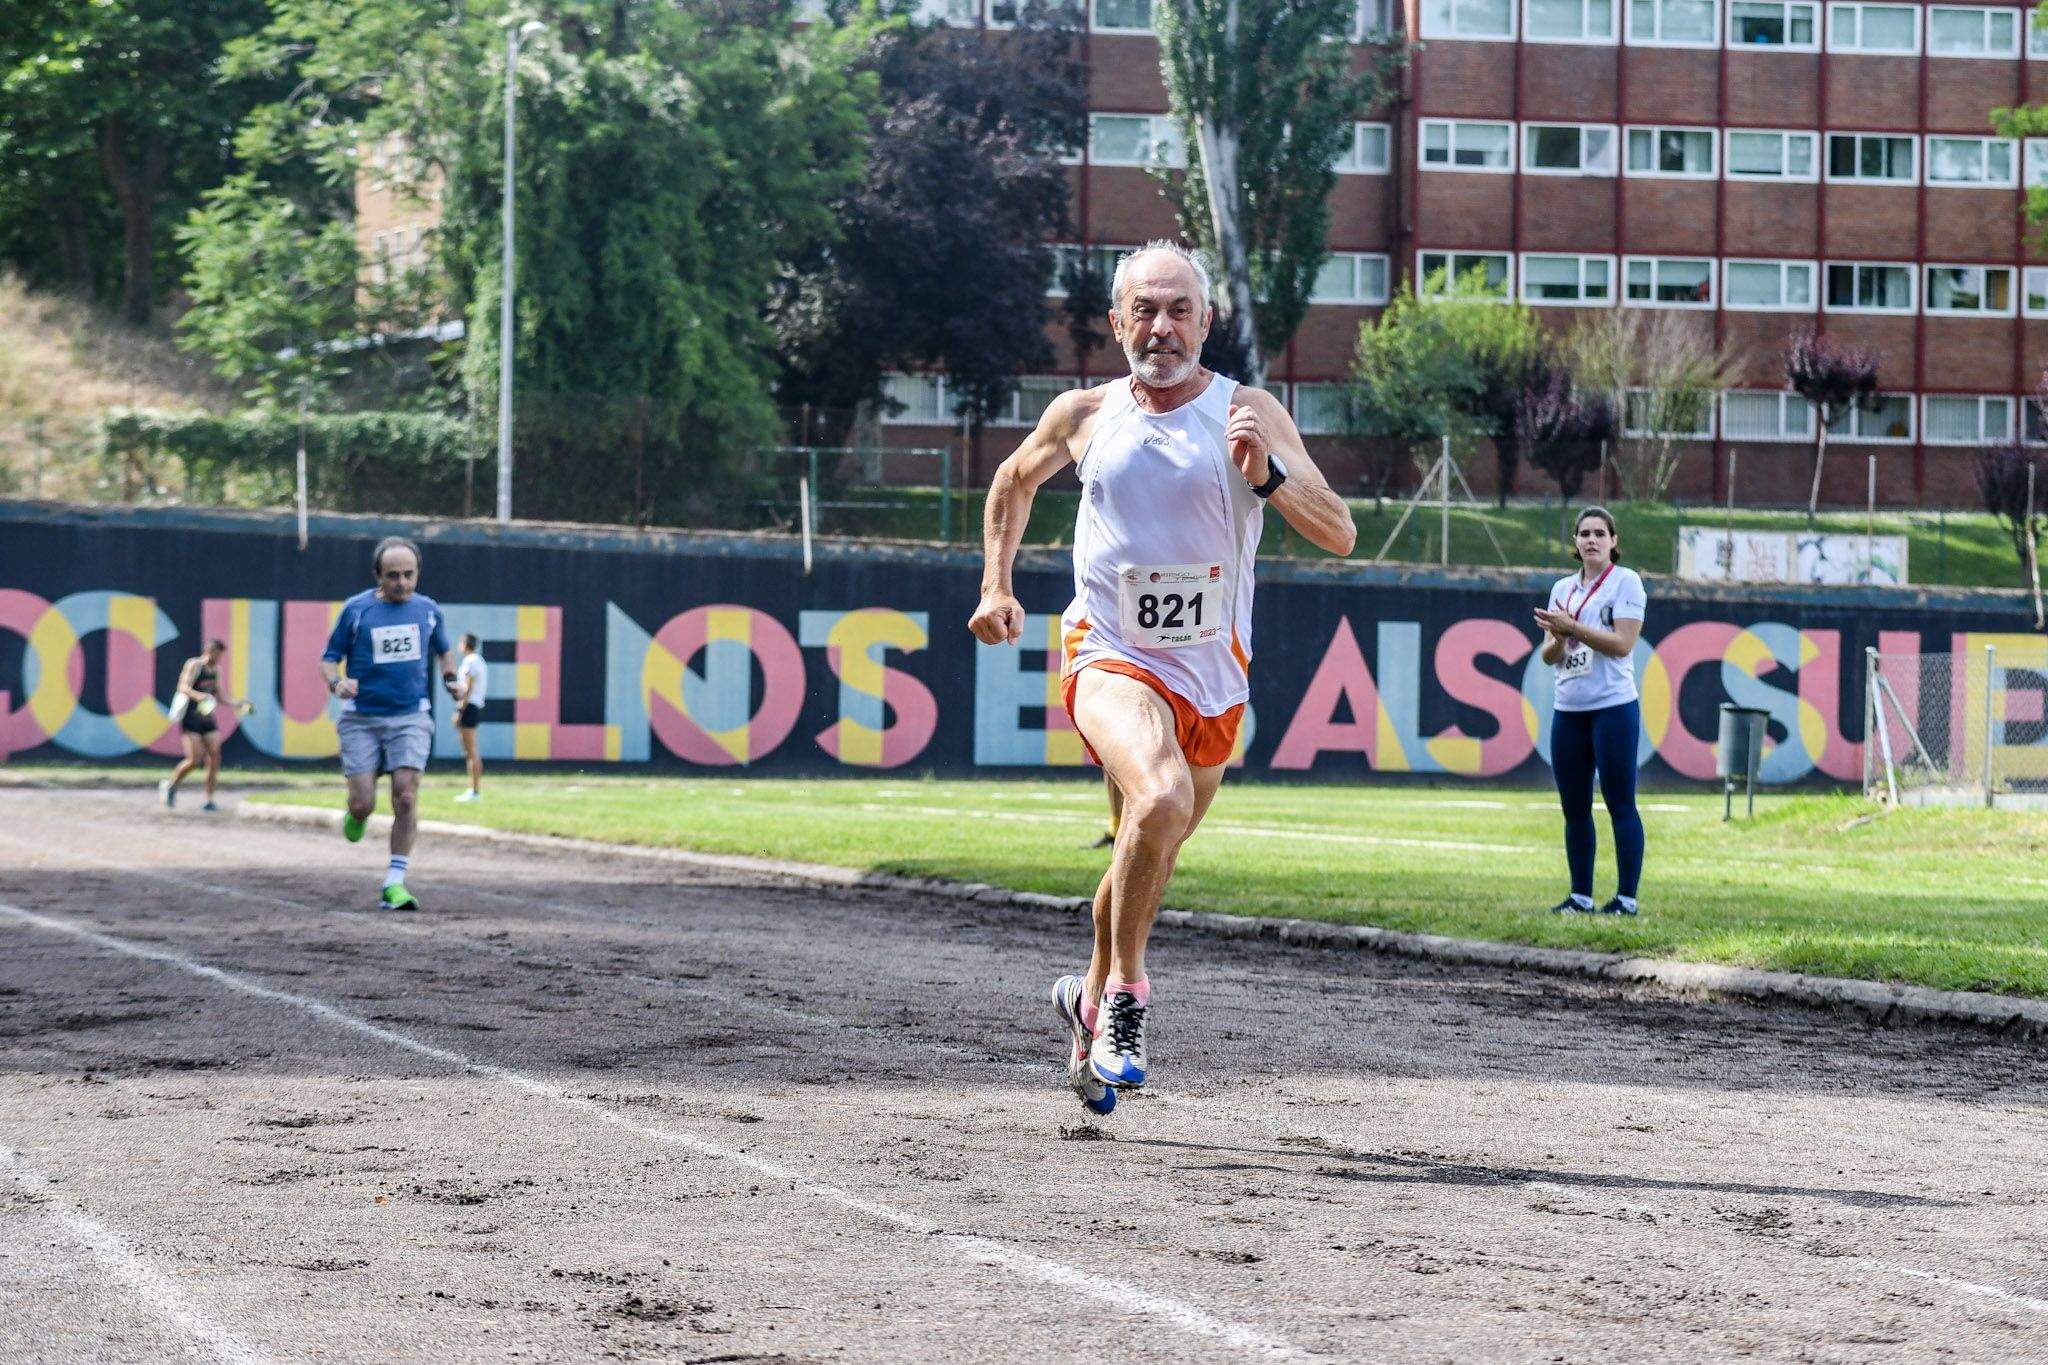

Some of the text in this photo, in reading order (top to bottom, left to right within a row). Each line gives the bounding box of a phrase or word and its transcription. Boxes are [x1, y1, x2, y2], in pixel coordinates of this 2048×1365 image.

[1137, 591, 1204, 629] 821
[1199, 628, 1217, 639] 2023
[382, 637, 413, 653] 825
[1565, 651, 1587, 670] 853
